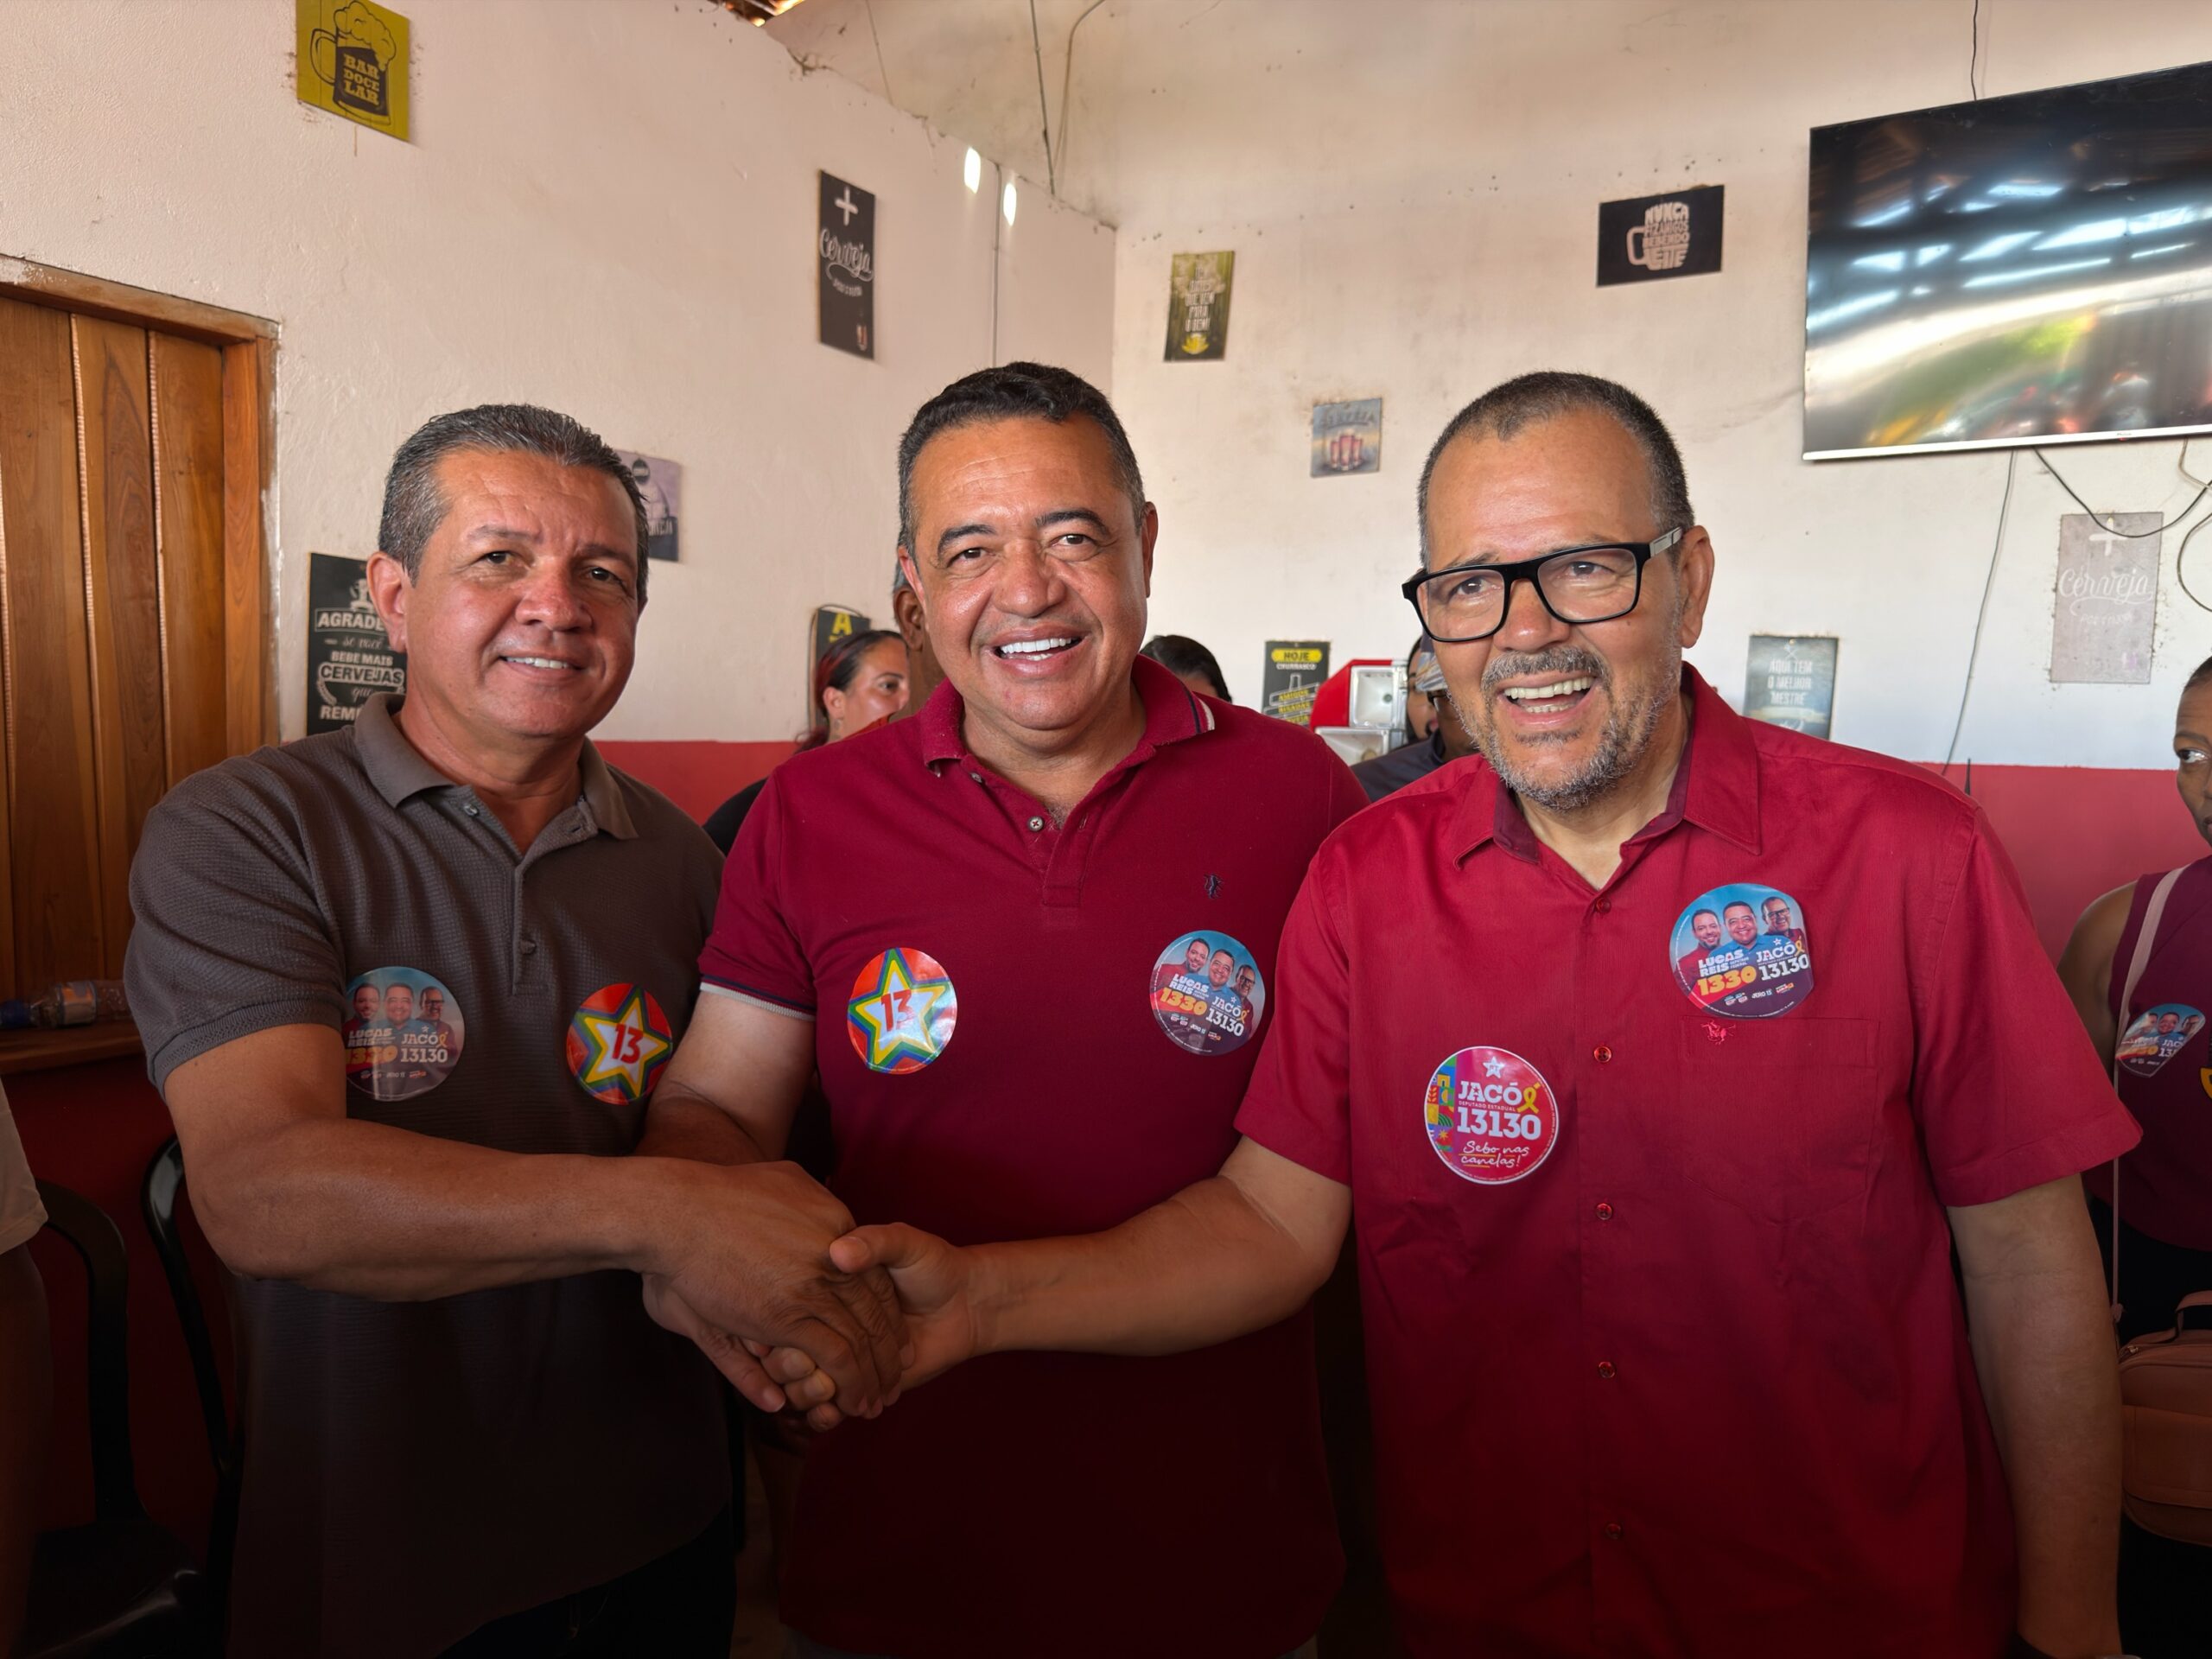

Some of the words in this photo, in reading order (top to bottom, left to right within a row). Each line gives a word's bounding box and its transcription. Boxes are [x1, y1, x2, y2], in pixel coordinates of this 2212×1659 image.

[343, 54, 381, 79] BAR
[343, 69, 380, 92] DOCE
[343, 79, 380, 105] LAR
[1644, 201, 1689, 225] NUNCA
[2059, 565, 2152, 606] Cerveja
[331, 651, 360, 664] BEBE
[361, 652, 393, 666] MAIS
[321, 664, 404, 684] CERVEJAS
[1698, 949, 1745, 969] LUCAS
[1756, 941, 1796, 963] JACÓ
[1700, 963, 1730, 977] REIS
[1758, 953, 1809, 982] 13130
[1169, 981, 1193, 995] REIS
[1172, 973, 1210, 994] LUCAS
[1697, 965, 1757, 996] 1330
[880, 988, 915, 1033] 13
[1160, 987, 1208, 1015] 1330
[1211, 996, 1242, 1017] JACÓ
[348, 1027, 393, 1039] LUCAS
[1205, 1008, 1244, 1037] 13130
[401, 1032, 439, 1045] JACÓ
[612, 1023, 645, 1064] 13
[400, 1048, 448, 1063] 13130
[1458, 1080, 1522, 1106] JACÓ
[1459, 1100, 1487, 1109] DEPUTADO
[1487, 1104, 1516, 1113] ESTADUAL
[1457, 1106, 1541, 1141] 13130
[1463, 1140, 1499, 1154] Sebo
[1503, 1146, 1529, 1157] nas
[1460, 1153, 1522, 1169] canelas!
